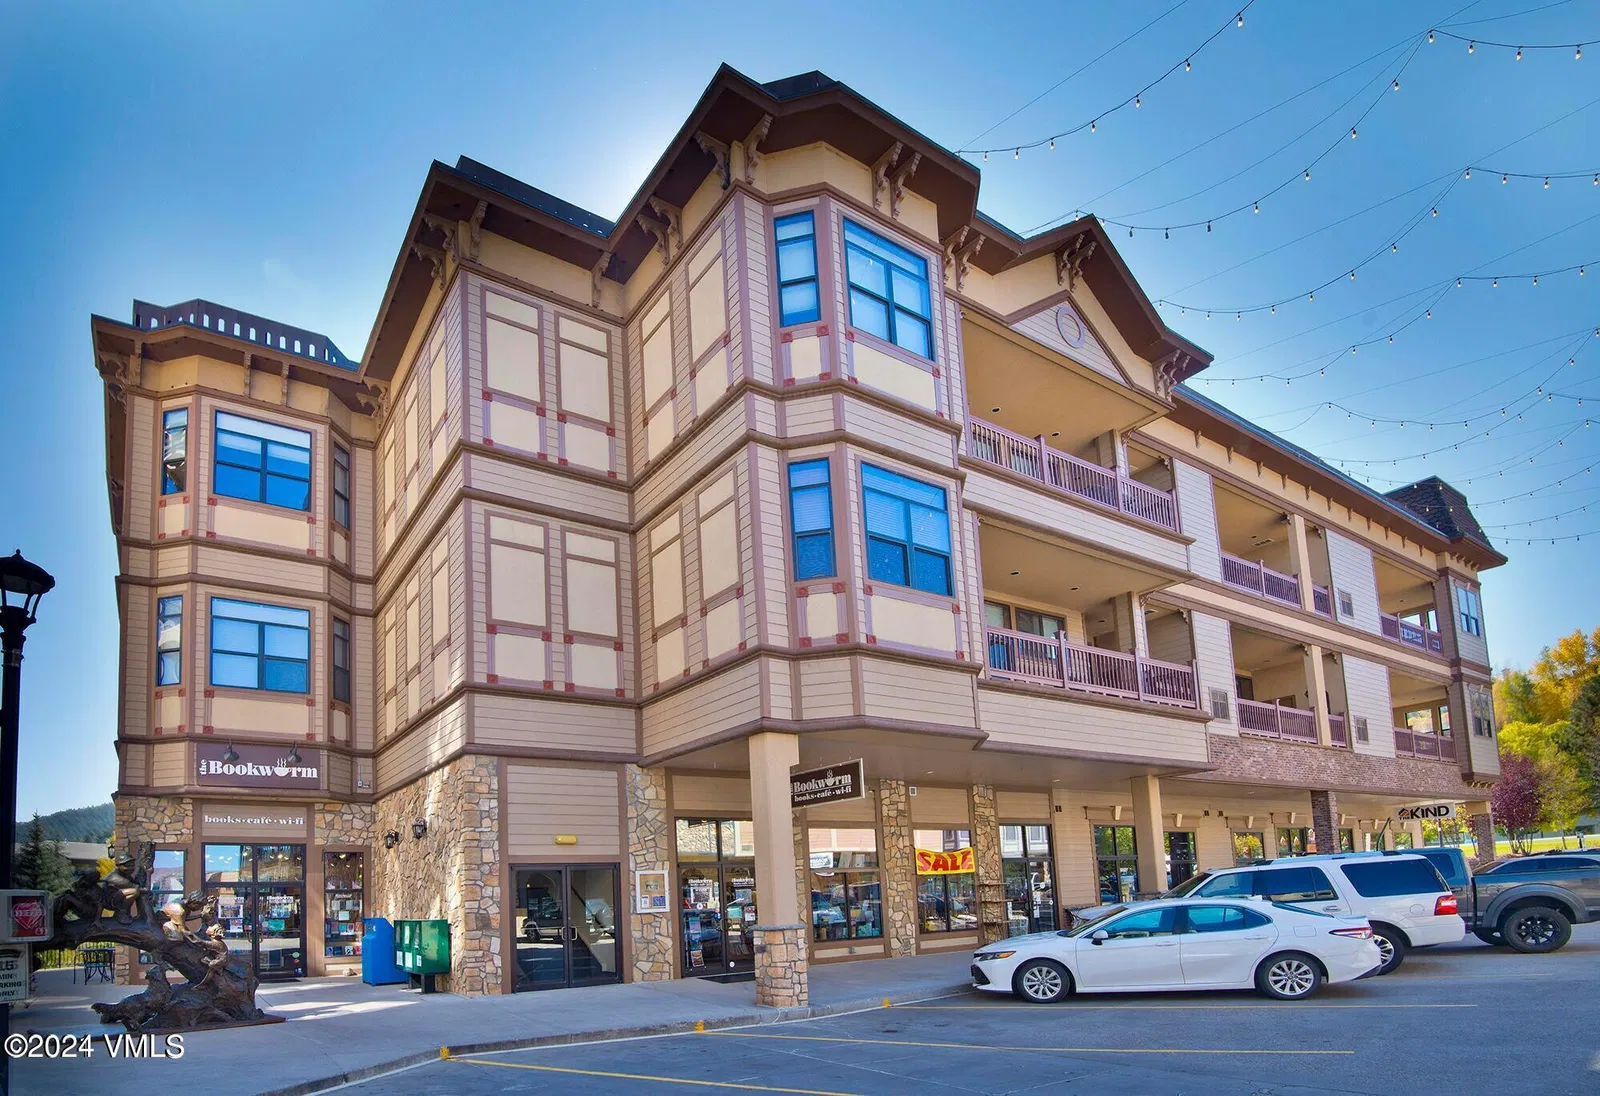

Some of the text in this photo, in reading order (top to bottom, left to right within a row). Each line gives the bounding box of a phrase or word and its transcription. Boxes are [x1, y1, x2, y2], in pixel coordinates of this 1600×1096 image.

[199, 759, 318, 778] the Bookworm
[793, 774, 852, 793] Bookworm
[794, 793, 815, 802] books
[204, 815, 304, 825] books café wi-fi
[1410, 805, 1450, 819] KIND
[917, 850, 974, 872] SALE
